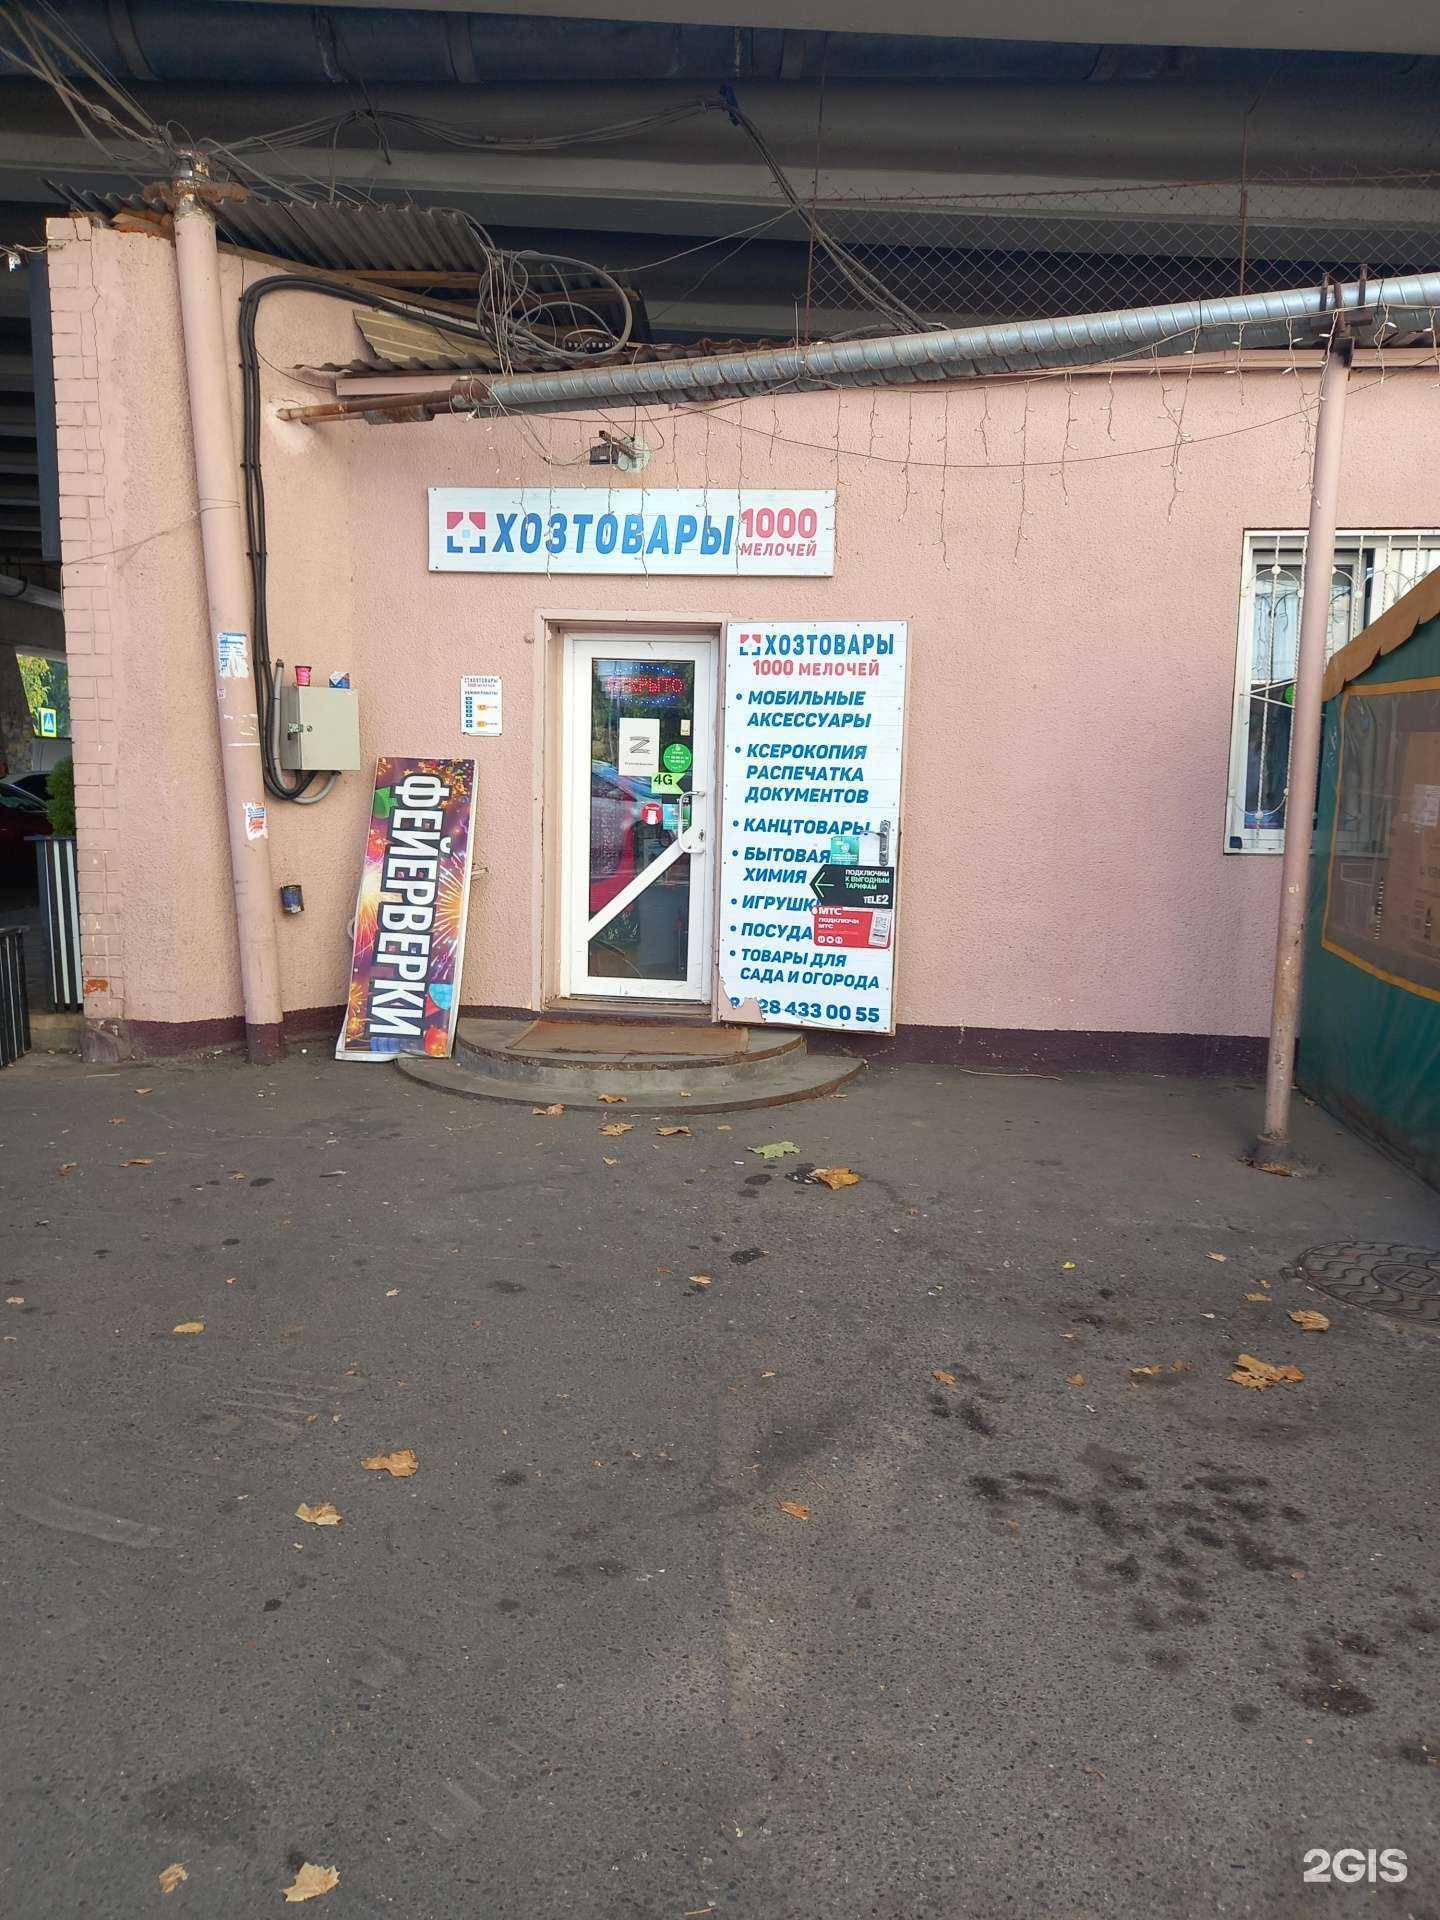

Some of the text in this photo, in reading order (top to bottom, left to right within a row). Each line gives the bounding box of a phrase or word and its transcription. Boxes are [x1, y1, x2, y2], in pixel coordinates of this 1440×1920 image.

[740, 508, 817, 539] 1000
[492, 512, 734, 555] ХОЗТОВАРЫ
[739, 540, 817, 558] МЕЛОЧЕЙ
[764, 633, 894, 656] ХОЗТОВАРЫ
[753, 658, 880, 676] 1000 МЕЛОЧЕЙ
[748, 690, 866, 706] МОБИЛЬНЫЕ
[747, 712, 872, 728] АКСЕССУАРЫ
[746, 743, 868, 760] КСЕРОКОПИЯ
[653, 773, 673, 786] 4G
[746, 765, 864, 781] РАСПЕЧАТКА
[744, 786, 869, 804] ДОКУМЕНТОВ
[743, 818, 871, 836] КАНЦТОВАРЫ
[744, 846, 831, 863] БЫТОВАЯ
[743, 867, 808, 884] ХИМИЯ
[845, 869, 890, 877] ПОДКЛЮЧИМ
[850, 876, 890, 884] ВЫГОДНЫМ
[369, 775, 451, 1037] ФЕЙЕРВЕРКИ
[742, 894, 821, 912] ИГРУШК
[863, 895, 889, 905] TELE2
[818, 906, 842, 915] МТС
[741, 922, 813, 942] ПОСУДА
[741, 948, 847, 969] ТОВАРЫ ДЛЯ
[740, 967, 880, 991] САДА И ОГОРОДА
[784, 1000, 822, 1019] 433
[825, 1004, 851, 1021] 00
[855, 1006, 880, 1023] 55
